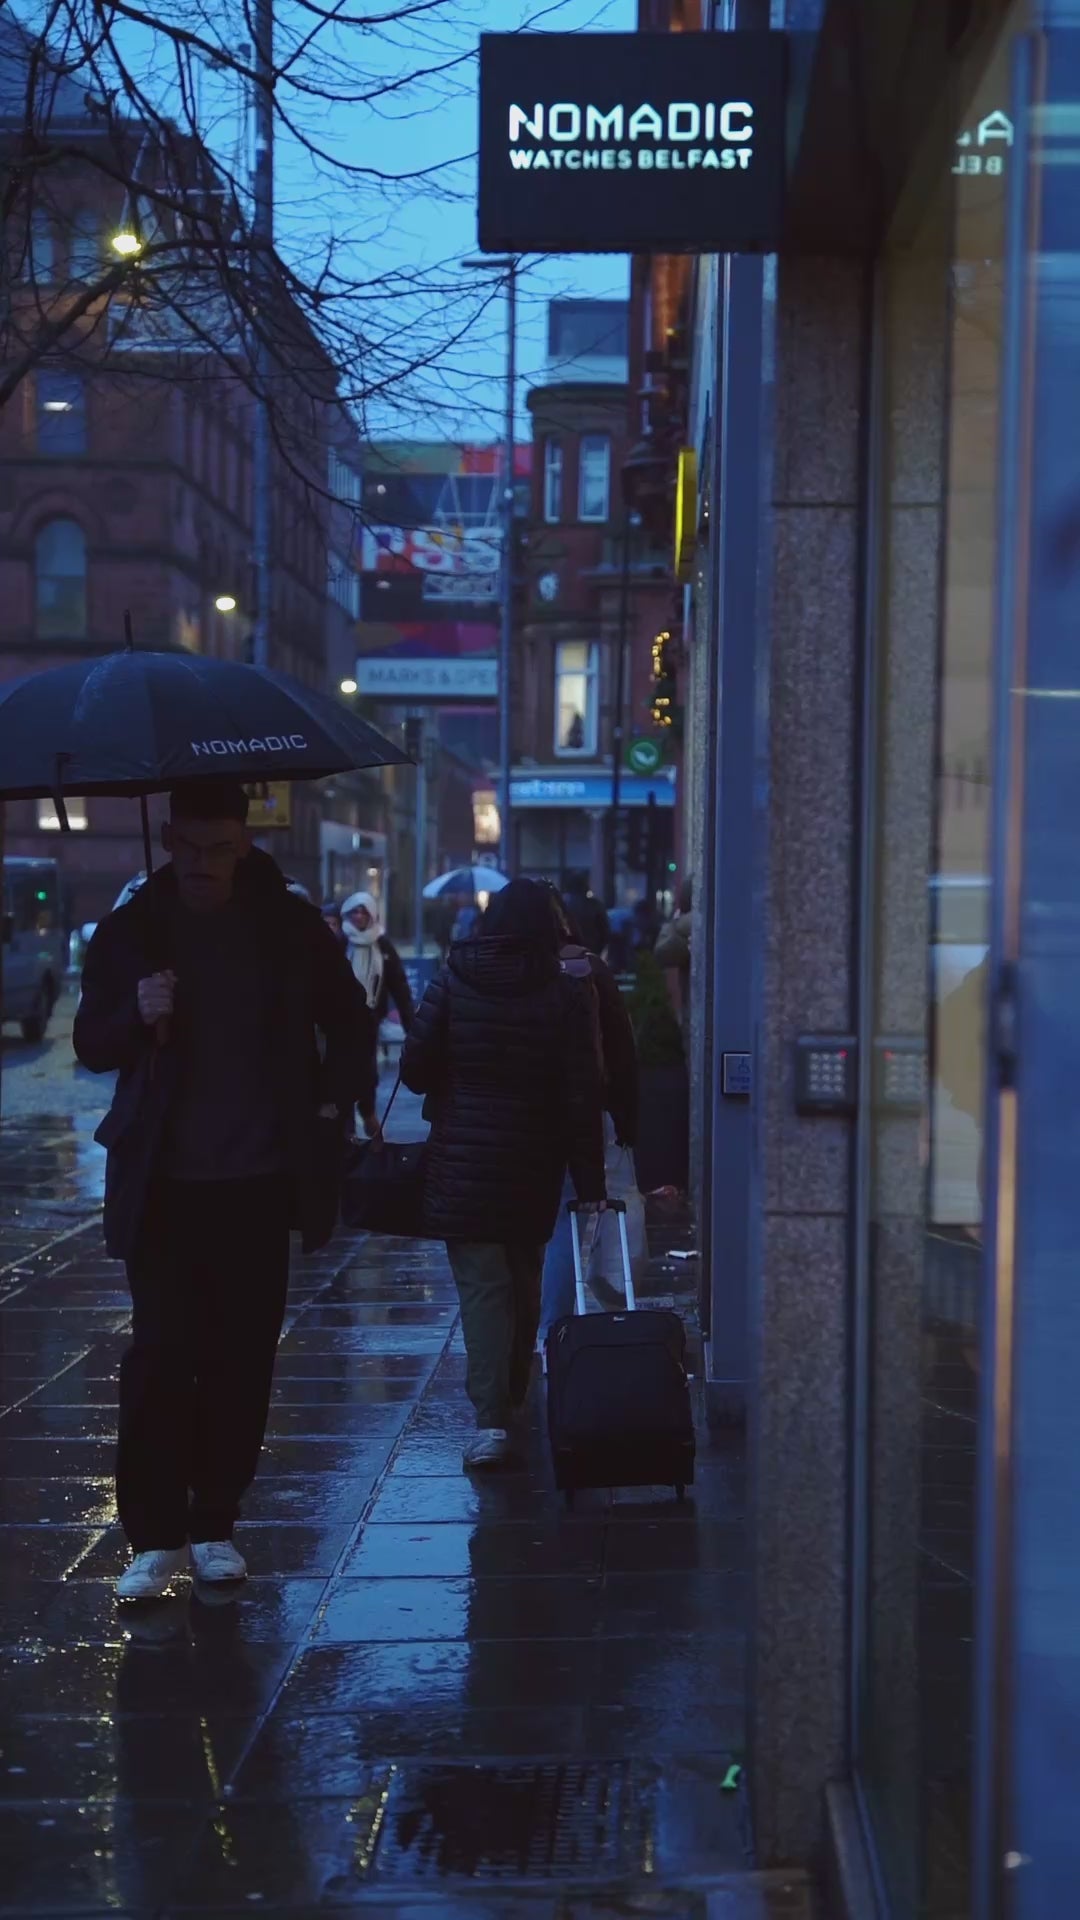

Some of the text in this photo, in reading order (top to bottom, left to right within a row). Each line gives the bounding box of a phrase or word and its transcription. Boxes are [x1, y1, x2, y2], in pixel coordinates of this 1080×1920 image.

[509, 102, 753, 141] NOMADIC
[509, 148, 753, 169] WATCHES BELFAST
[191, 735, 307, 755] NOMADIC
